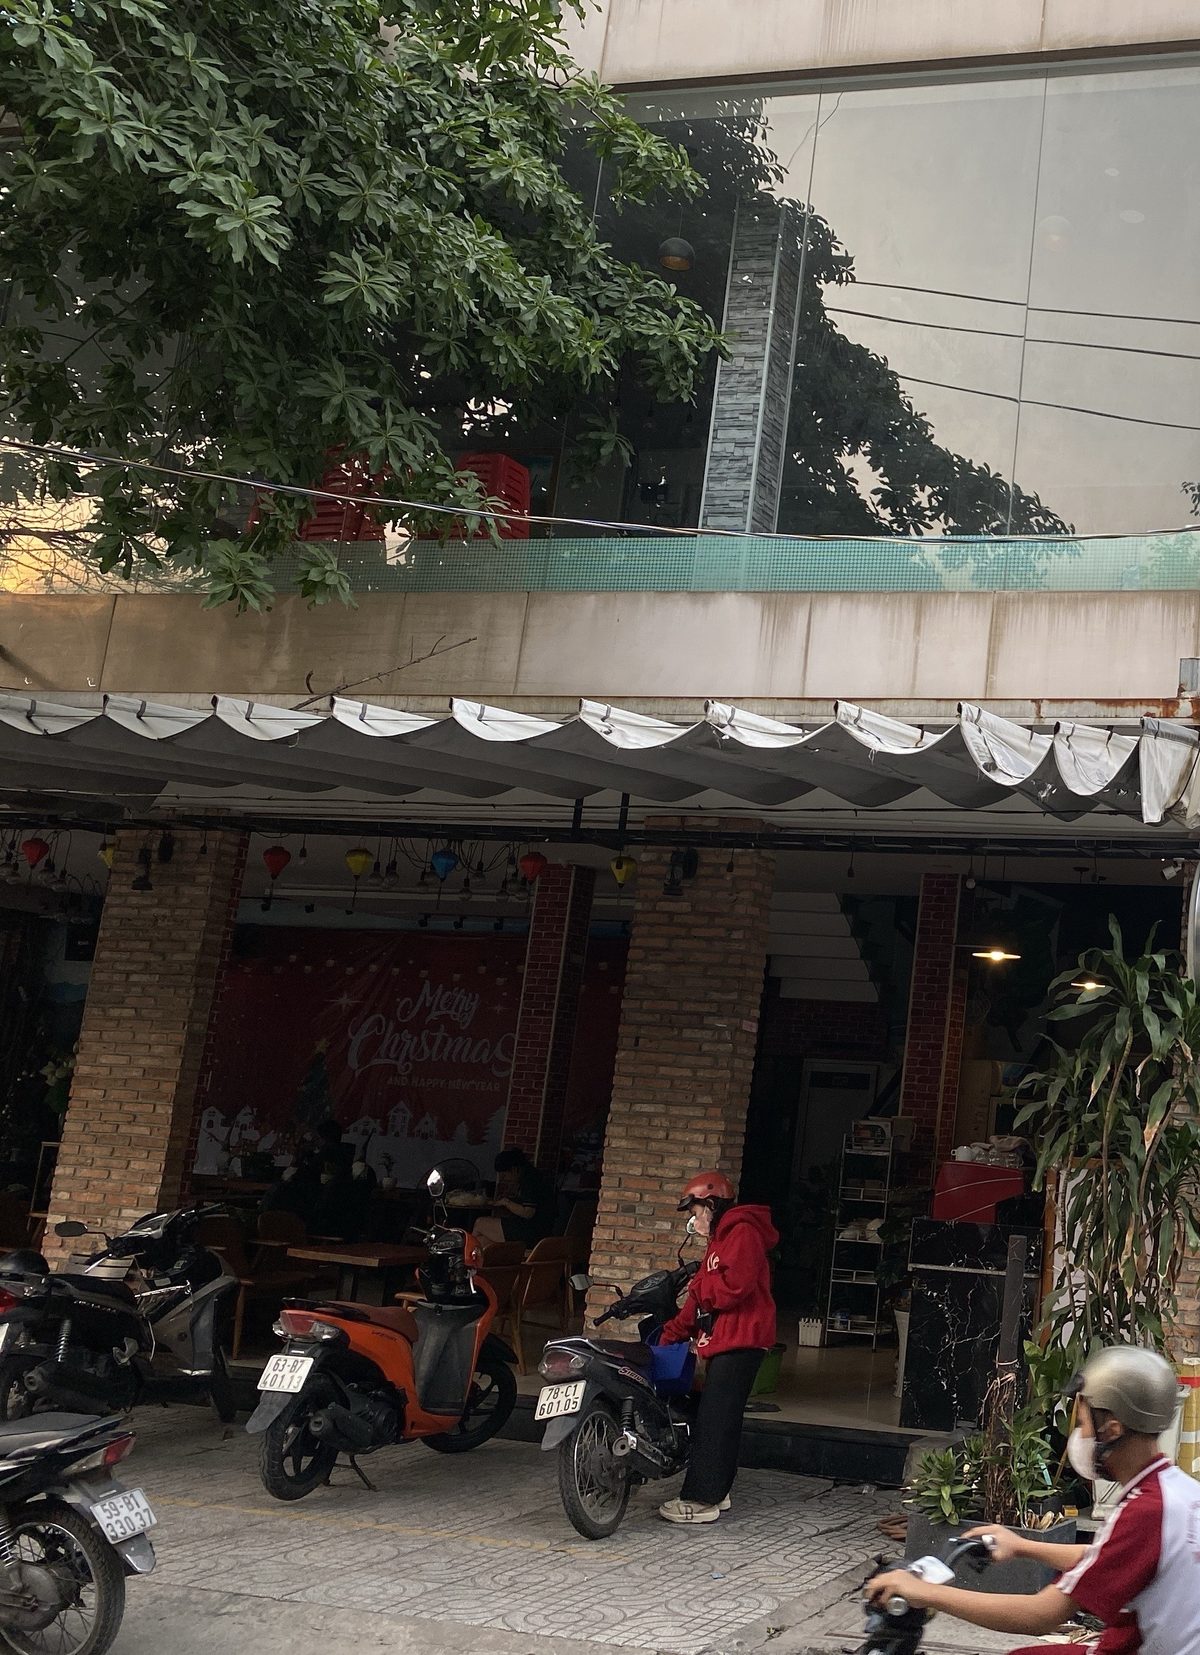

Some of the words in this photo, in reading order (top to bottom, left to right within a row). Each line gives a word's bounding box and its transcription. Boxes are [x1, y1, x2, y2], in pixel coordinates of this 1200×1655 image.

[396, 979, 480, 1030] Merry
[411, 1077, 446, 1089] HAPPY
[272, 1357, 306, 1374] 63-B7
[546, 1383, 579, 1402] 78-C1
[538, 1396, 580, 1417] 601.05
[100, 1493, 141, 1520] 59-B1
[106, 1507, 153, 1541] 330.37
